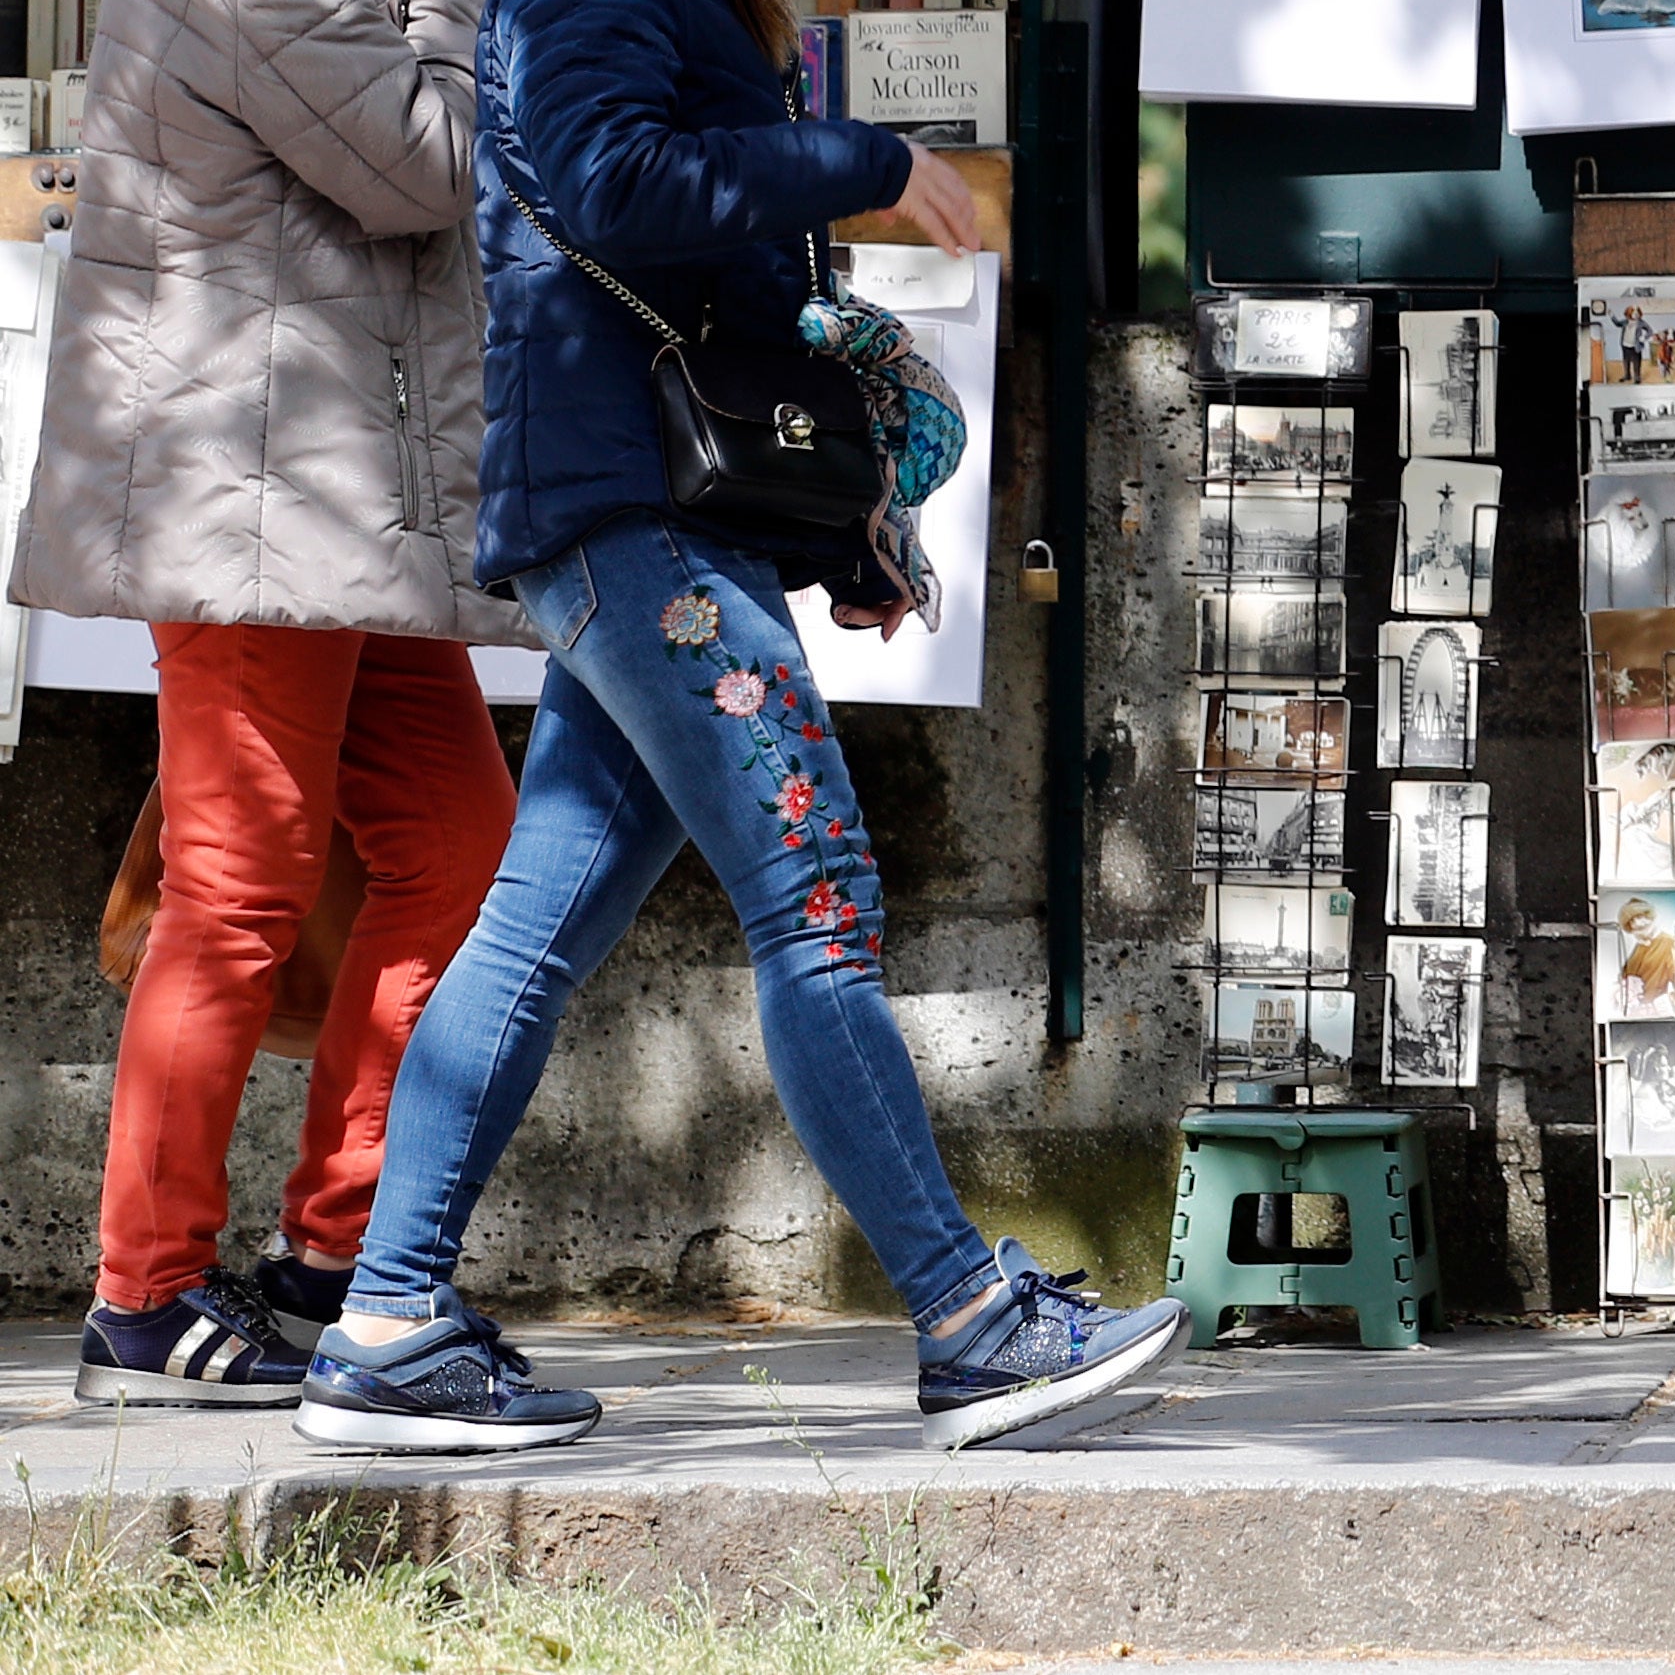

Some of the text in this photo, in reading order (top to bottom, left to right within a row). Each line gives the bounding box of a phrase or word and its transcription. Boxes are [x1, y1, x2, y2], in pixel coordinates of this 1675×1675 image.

[855, 16, 990, 41] Josyane Savigneau
[886, 47, 961, 72] Carson
[872, 74, 979, 101] McCullers
[871, 104, 887, 117] Un
[957, 102, 977, 117] fille
[1253, 307, 1312, 326] PARIS
[1245, 354, 1306, 365] LA CARTE
